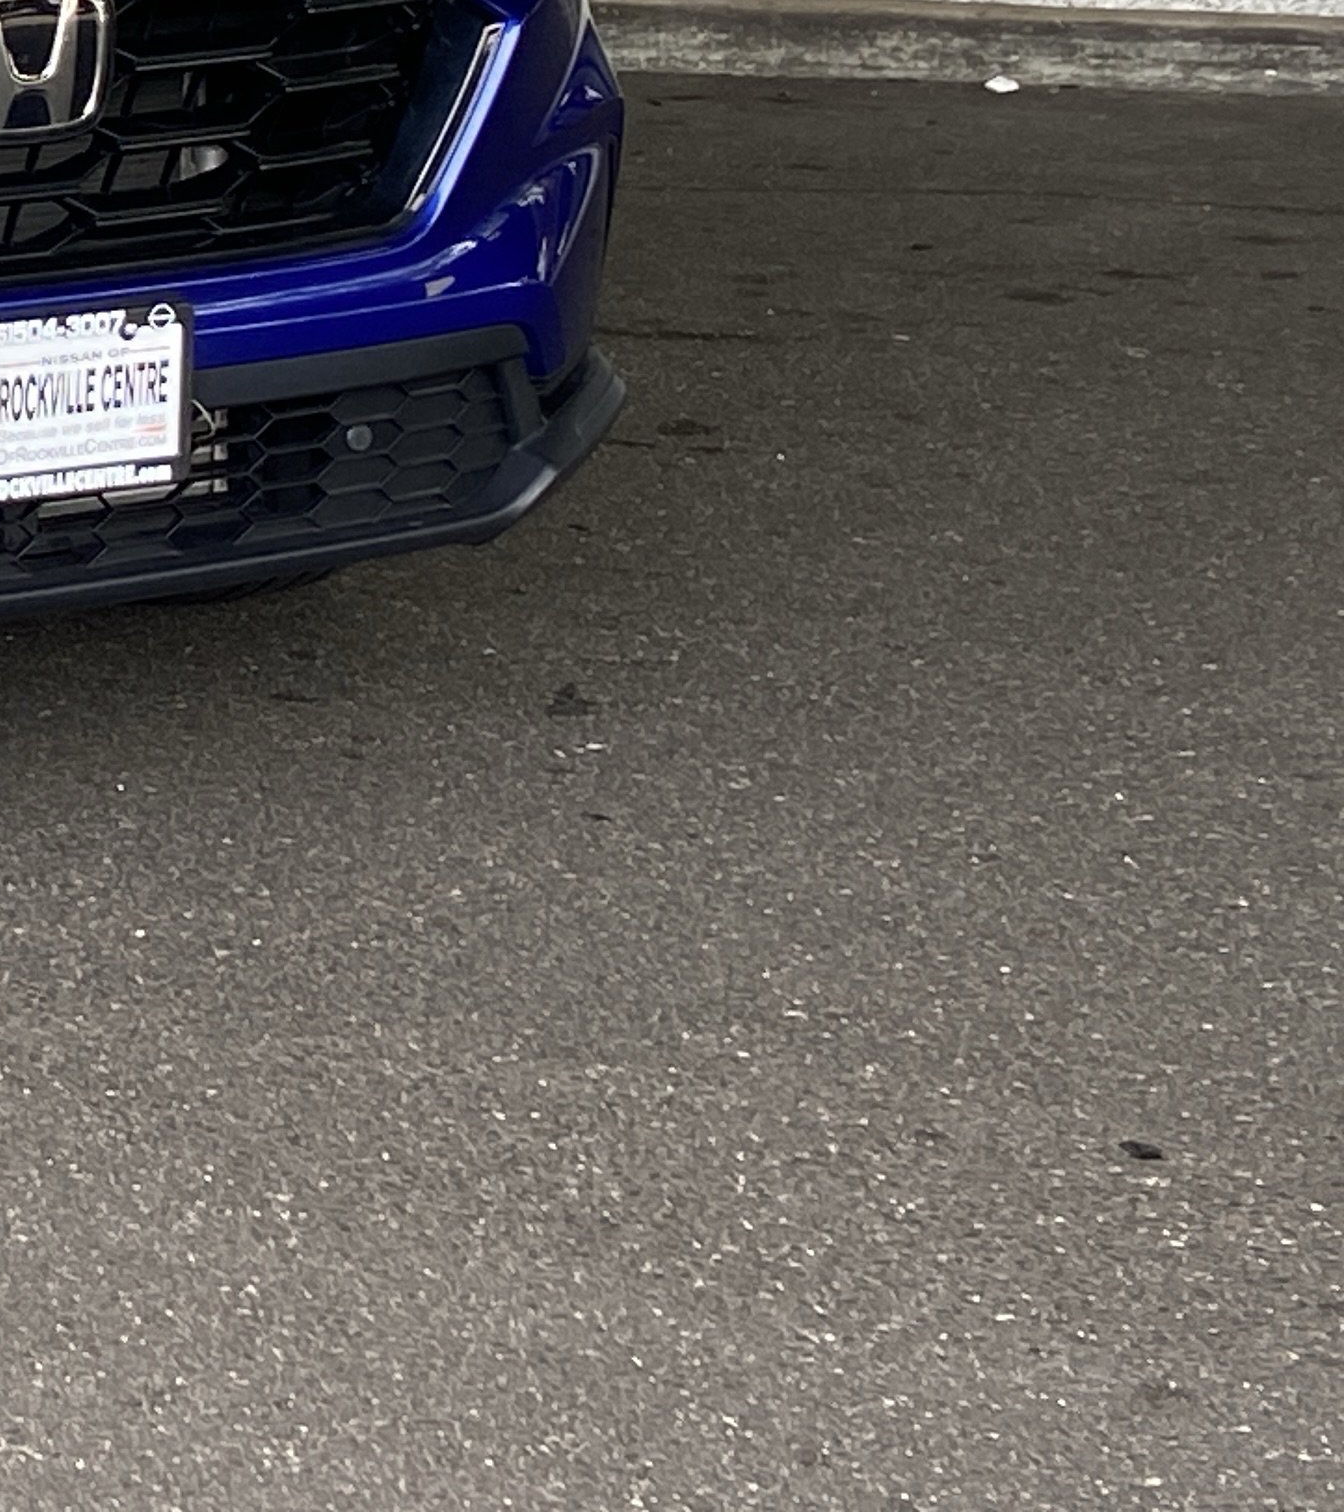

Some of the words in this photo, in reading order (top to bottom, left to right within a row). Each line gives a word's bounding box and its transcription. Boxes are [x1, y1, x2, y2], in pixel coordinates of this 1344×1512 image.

[41, 350, 102, 367] NISSAN
[0, 367, 96, 423] ROCKVILLE
[101, 359, 171, 409] CENTRE
